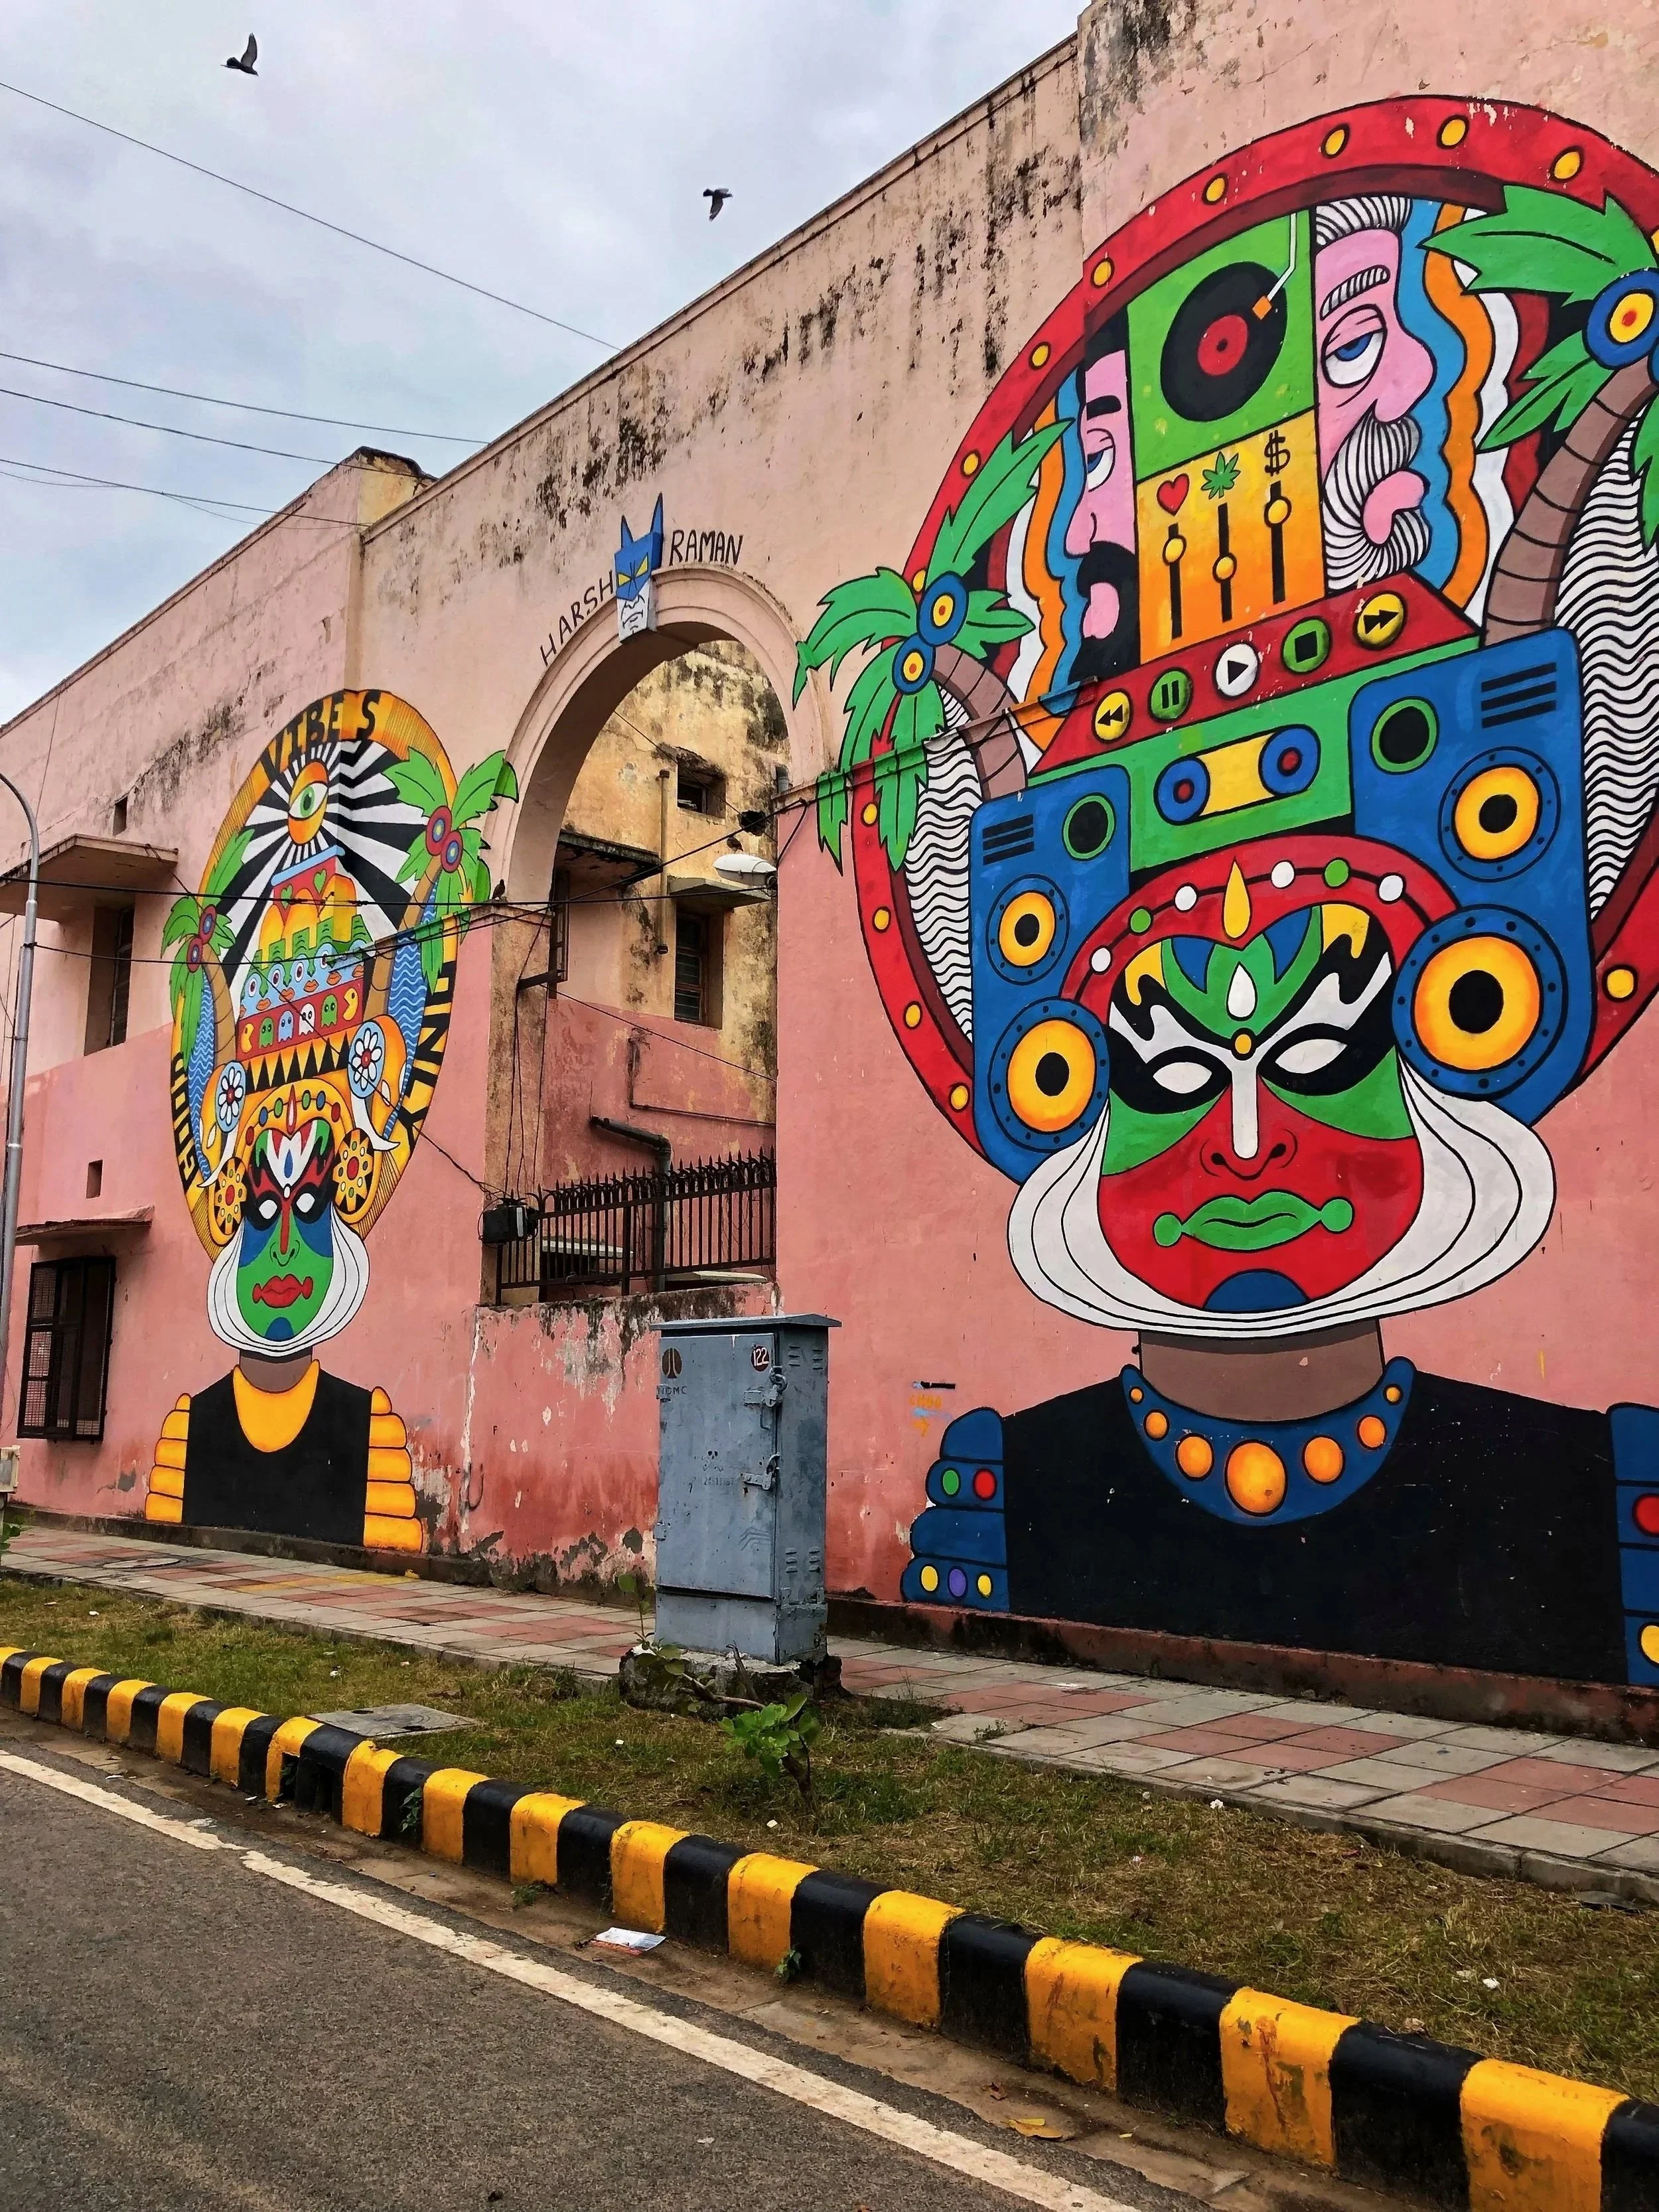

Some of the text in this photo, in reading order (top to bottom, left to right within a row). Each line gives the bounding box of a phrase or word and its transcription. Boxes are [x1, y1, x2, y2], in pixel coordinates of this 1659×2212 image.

[539, 529, 743, 666] HARSH RAMAN
[171, 689, 457, 1193] GOOD VIBES ONLY
[753, 1347, 770, 1366] 122
